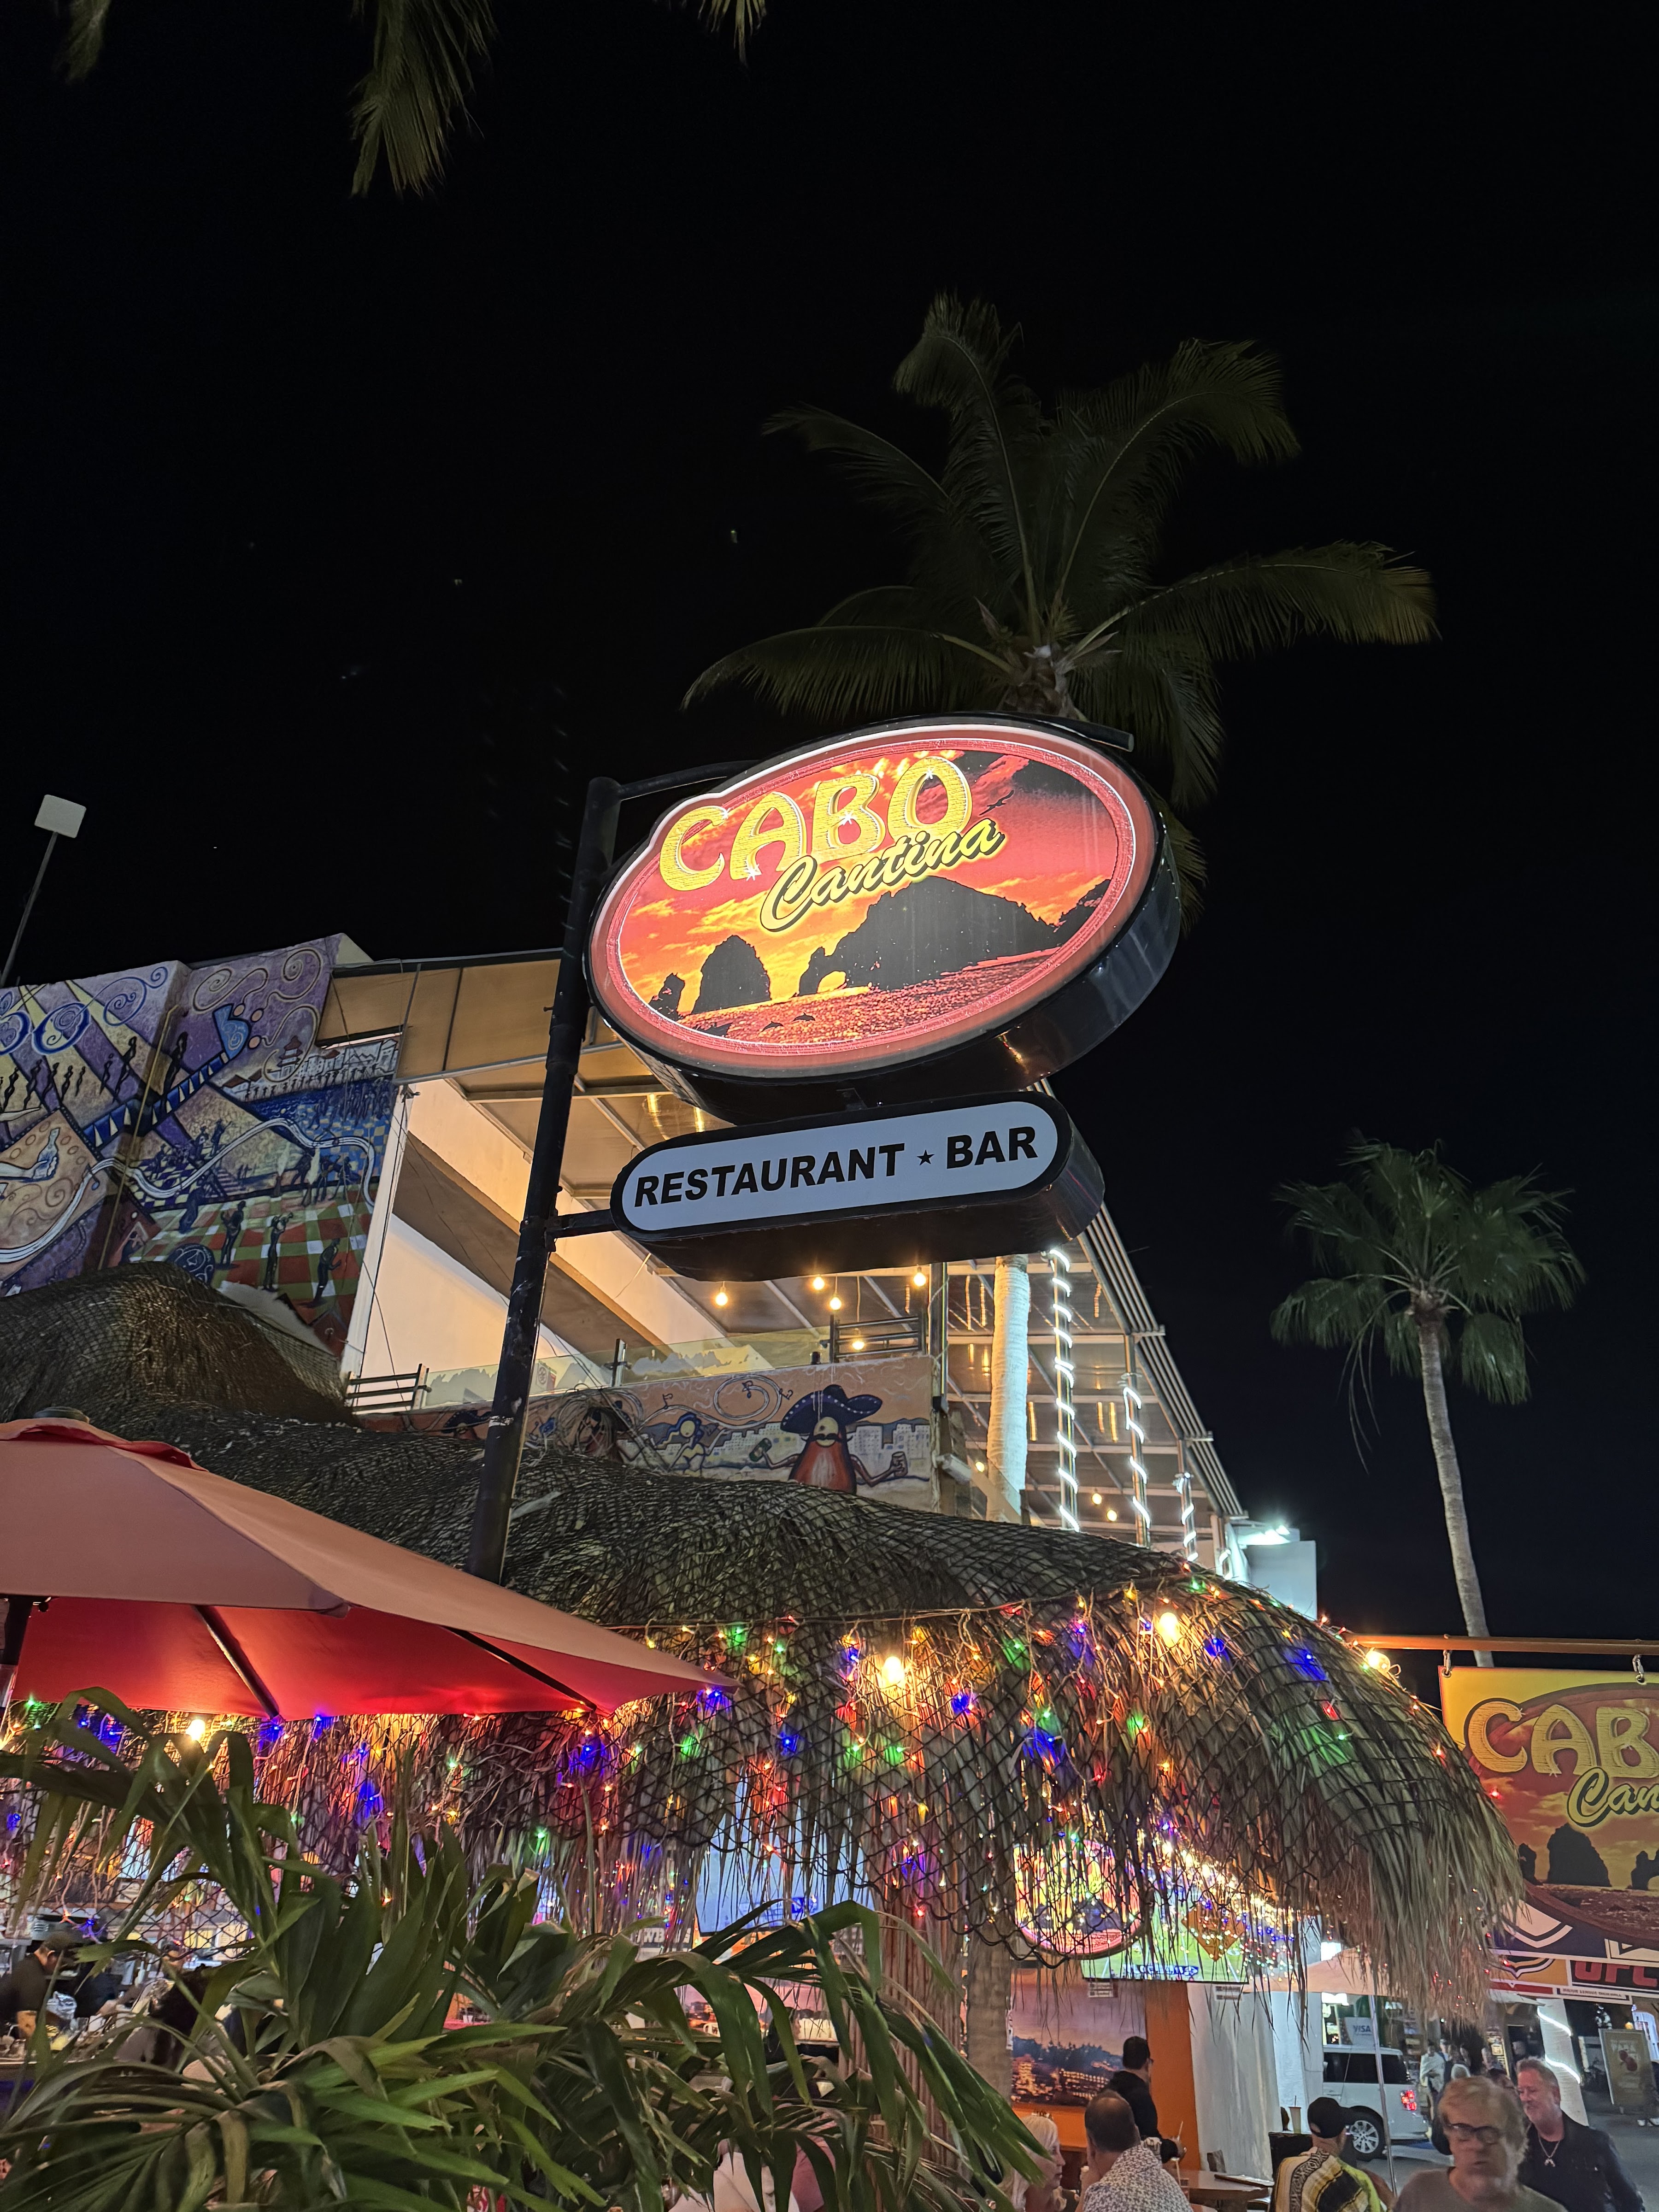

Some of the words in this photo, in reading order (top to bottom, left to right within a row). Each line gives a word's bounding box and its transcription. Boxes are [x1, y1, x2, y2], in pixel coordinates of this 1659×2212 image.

[659, 756, 973, 891] CABO
[760, 818, 1006, 932] Cantina
[634, 1143, 906, 1208] RESTAURANT
[946, 1126, 1038, 1170] BAR
[1353, 2024, 1371, 2033] VISA
